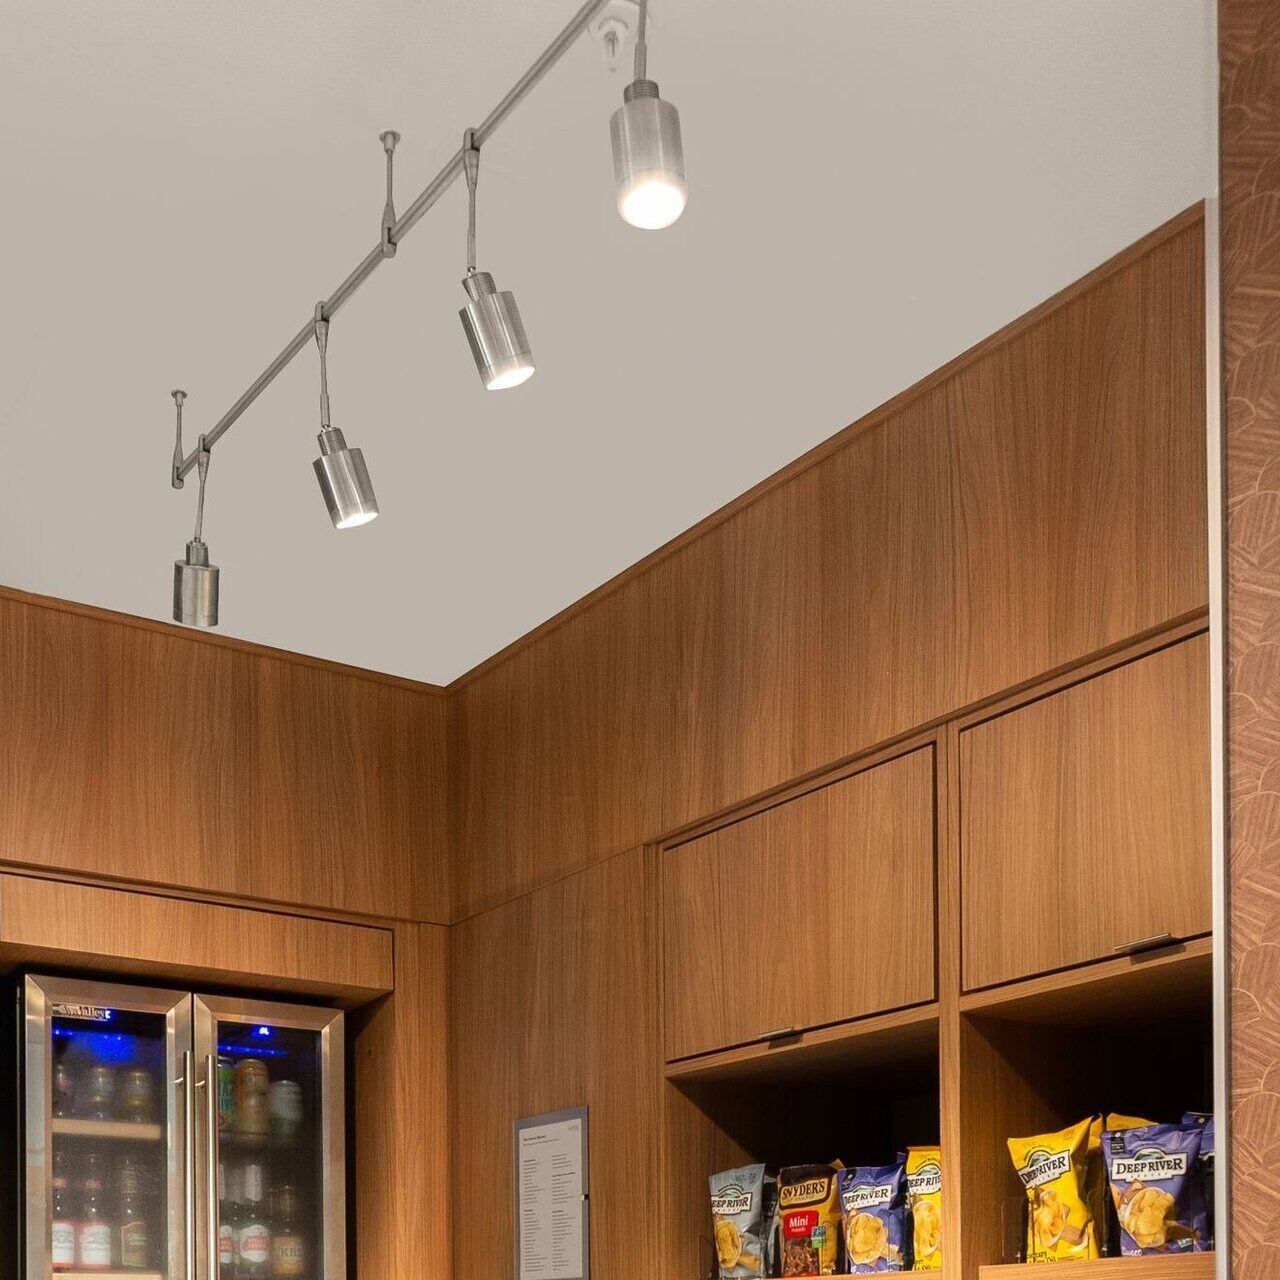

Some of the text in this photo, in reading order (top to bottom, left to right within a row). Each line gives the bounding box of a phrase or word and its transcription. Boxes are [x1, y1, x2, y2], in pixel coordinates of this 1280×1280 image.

[1037, 1156, 1067, 1177] RIVER
[1116, 1159, 1184, 1175] DEEP RIVER
[781, 1179, 825, 1200] SNYDER'S
[712, 1198, 728, 1209] EEP
[789, 1217, 809, 1228] Mini
